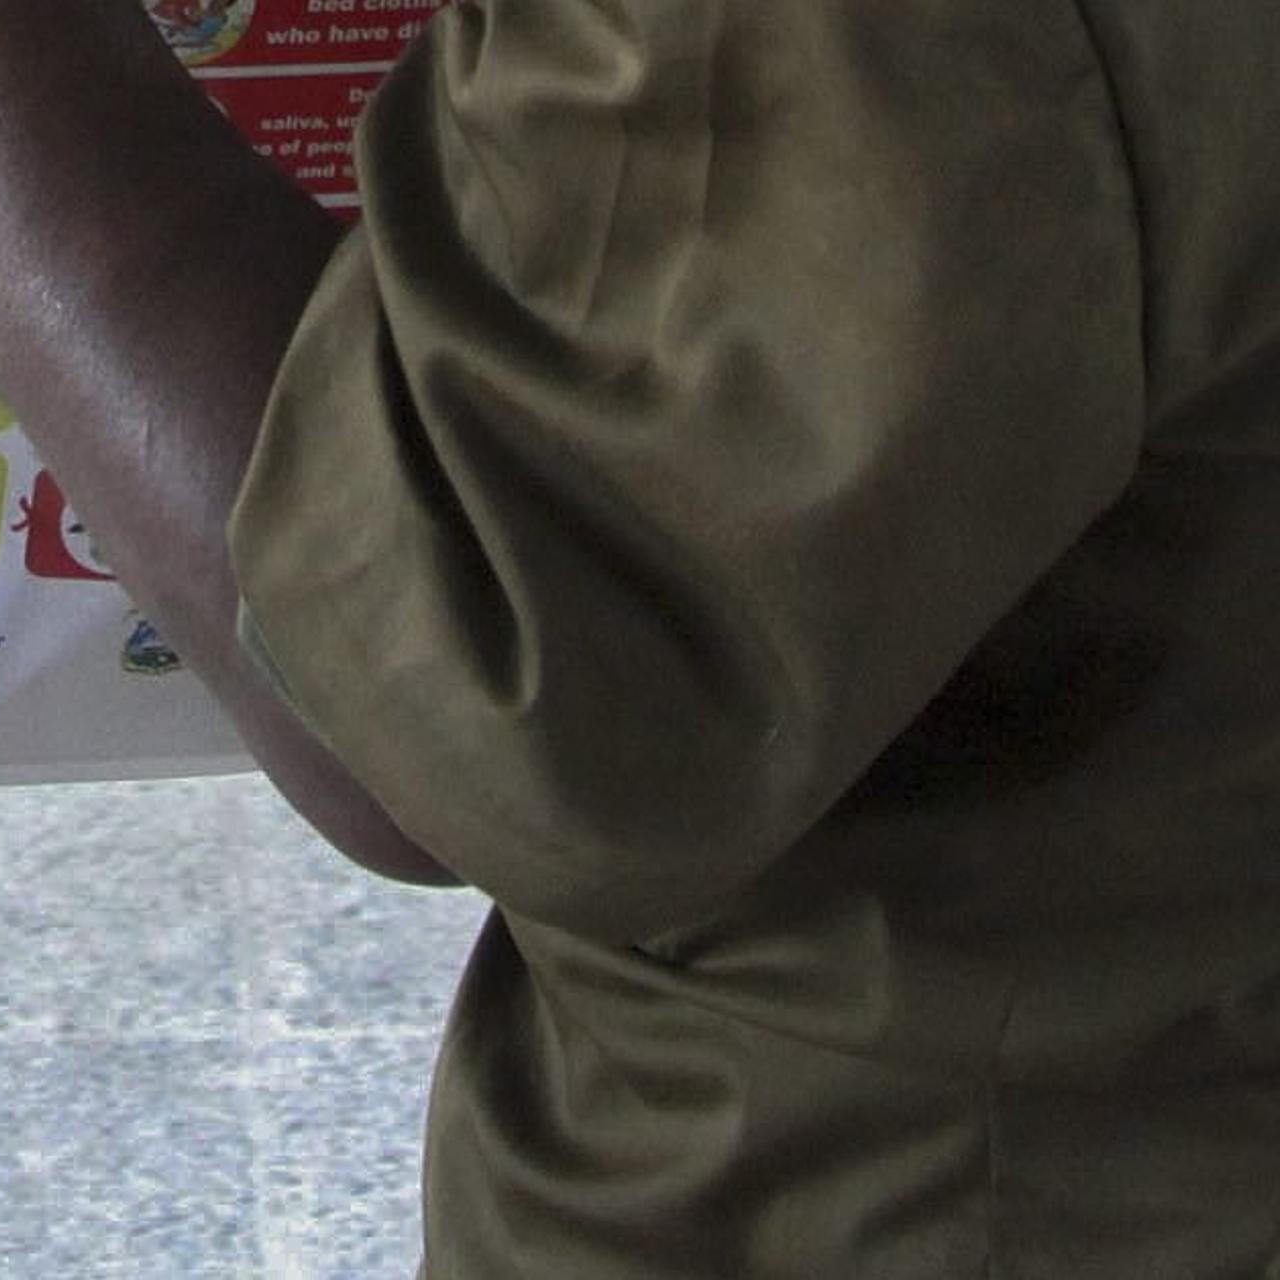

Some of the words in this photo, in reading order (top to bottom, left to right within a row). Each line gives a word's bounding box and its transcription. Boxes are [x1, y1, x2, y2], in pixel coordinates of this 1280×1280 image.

[265, 25, 321, 45] who
[328, 24, 389, 43] have
[260, 114, 330, 131] saliva,
[278, 139, 302, 156] of
[296, 163, 336, 179] and
